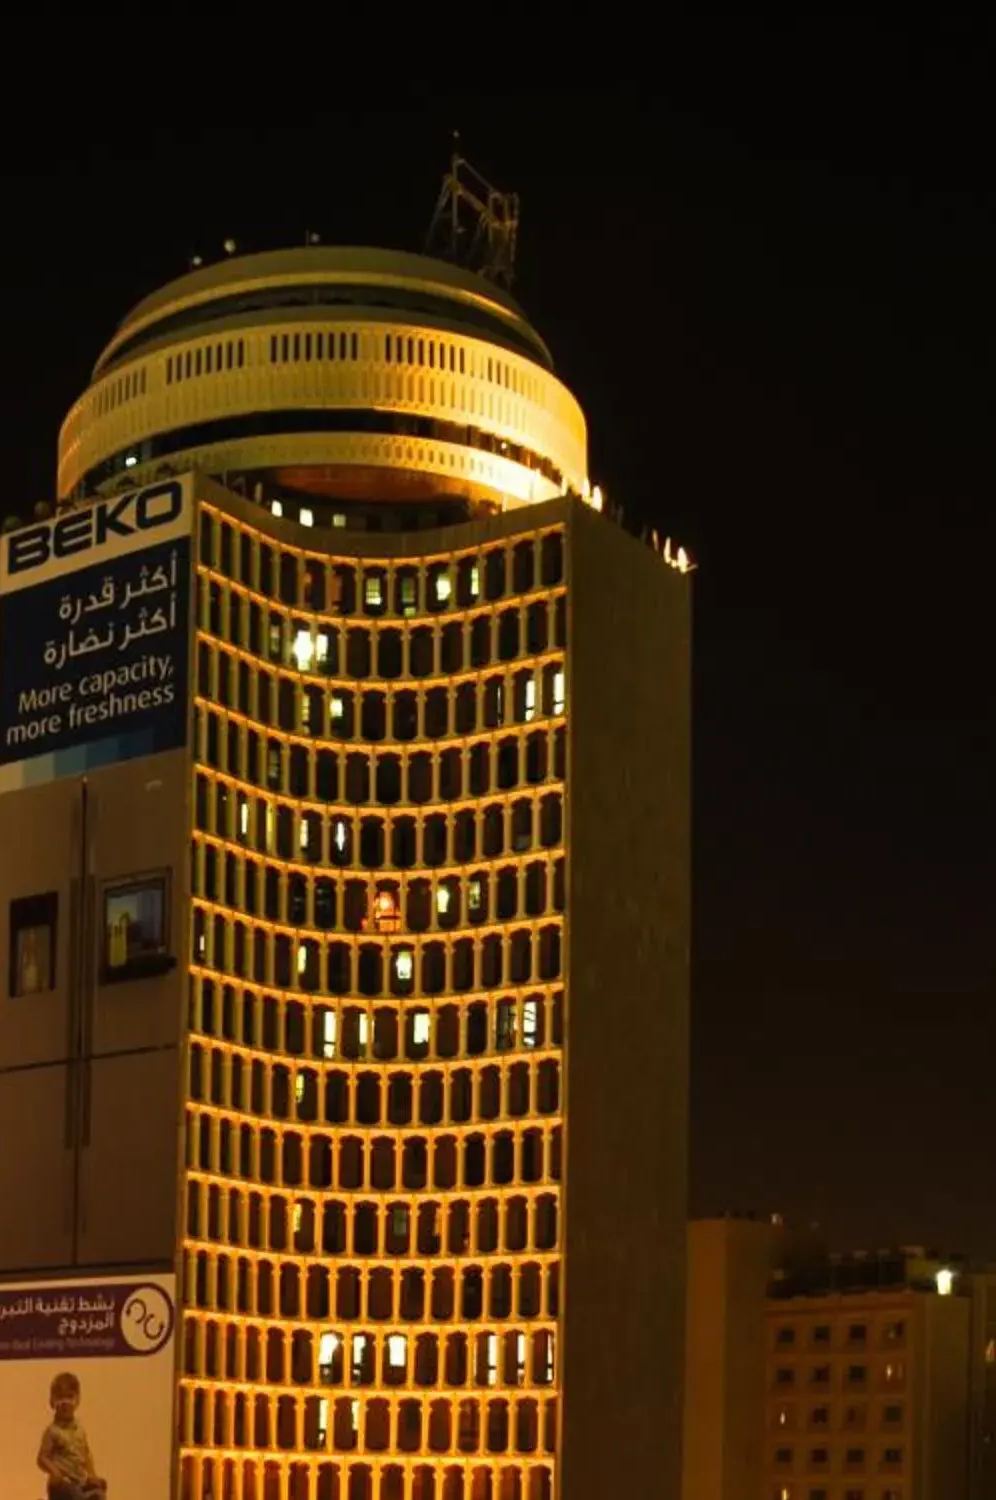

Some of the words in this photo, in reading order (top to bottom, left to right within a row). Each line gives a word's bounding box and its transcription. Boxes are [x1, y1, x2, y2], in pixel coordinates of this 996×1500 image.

[7, 480, 183, 575] BEKO
[59, 575, 115, 625] قدرة
[119, 549, 178, 610] أكثر
[43, 621, 115, 669] نضارة
[118, 591, 177, 651] أكثر
[6, 715, 62, 746] more
[69, 683, 175, 729] freshness
[18, 682, 73, 715] More
[78, 654, 174, 696] capacity,
